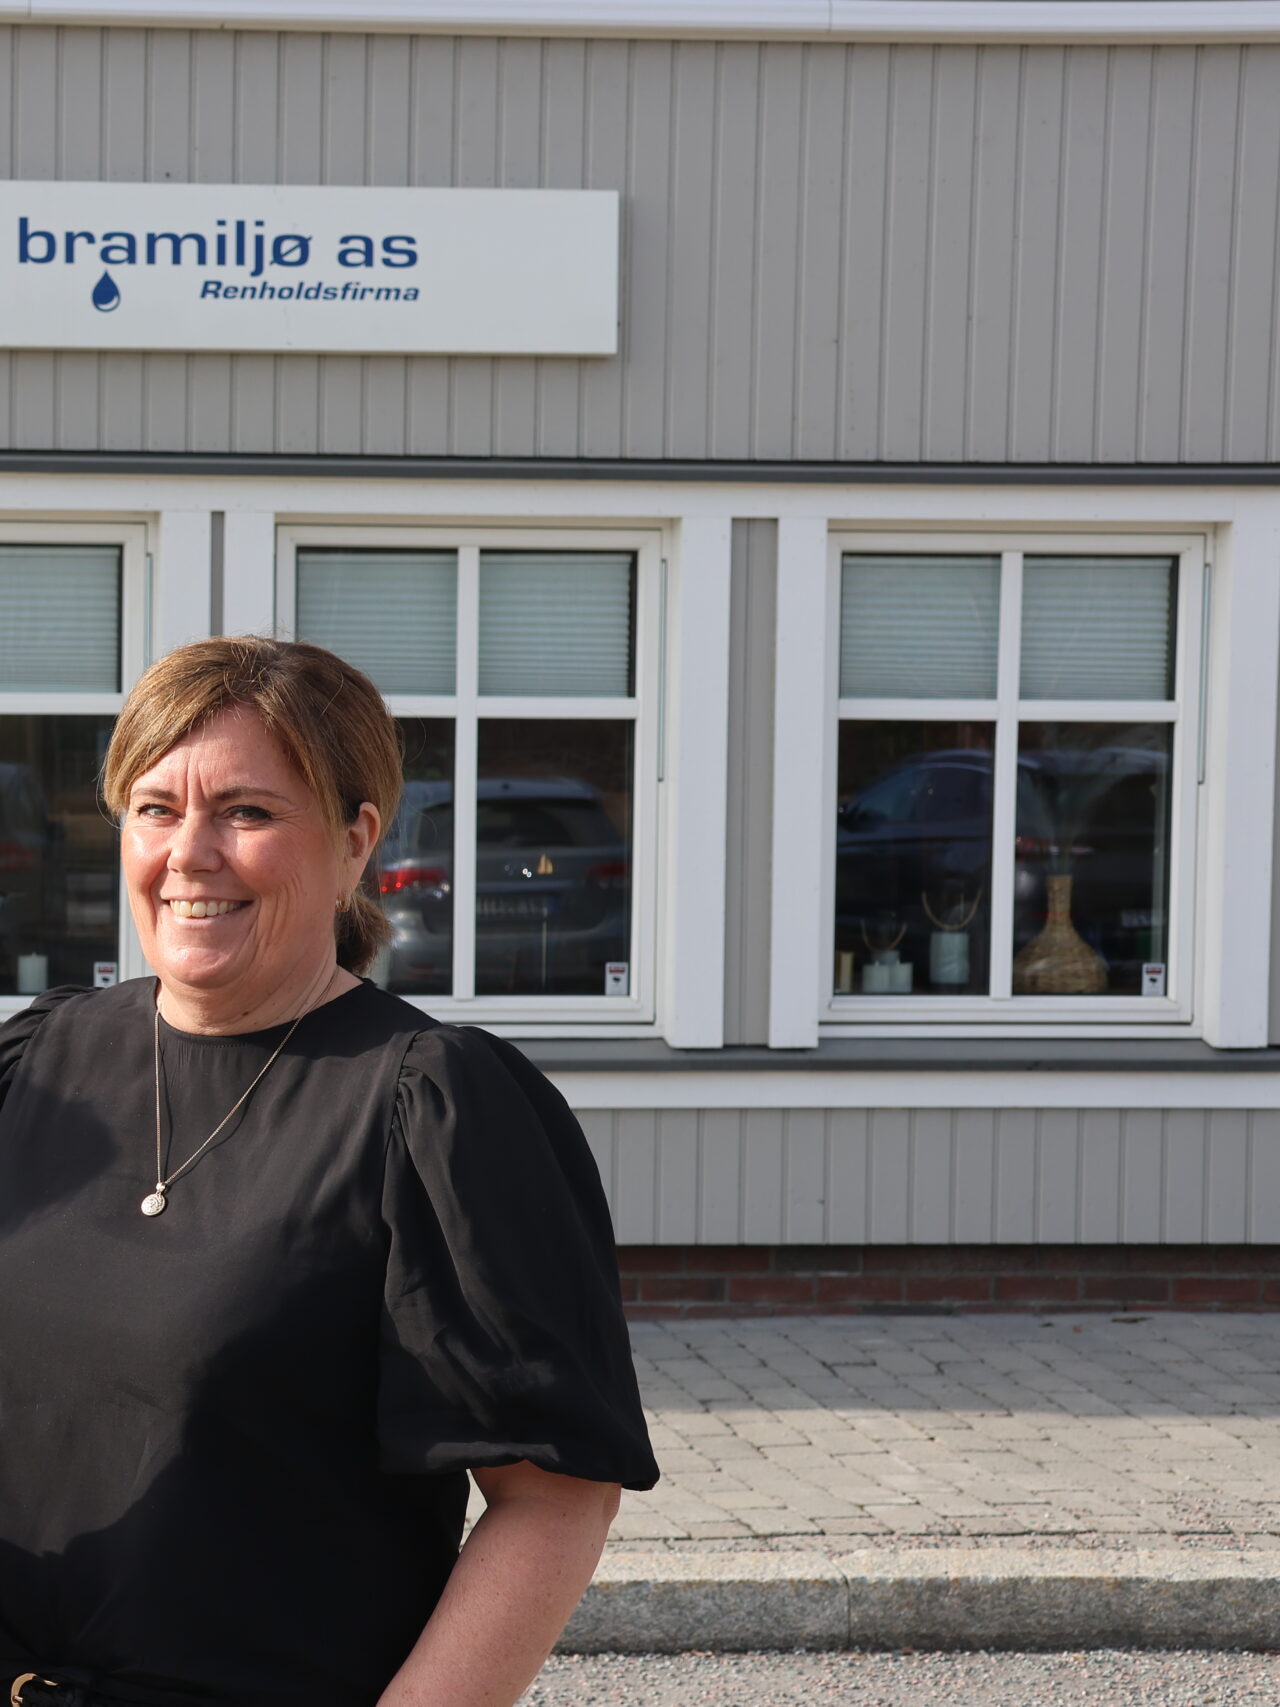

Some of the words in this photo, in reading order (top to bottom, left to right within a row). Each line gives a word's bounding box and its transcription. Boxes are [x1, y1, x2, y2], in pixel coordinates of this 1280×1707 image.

[18, 216, 313, 277] bramiljø
[336, 234, 419, 268] as
[199, 280, 420, 302] Renholdsfirma
